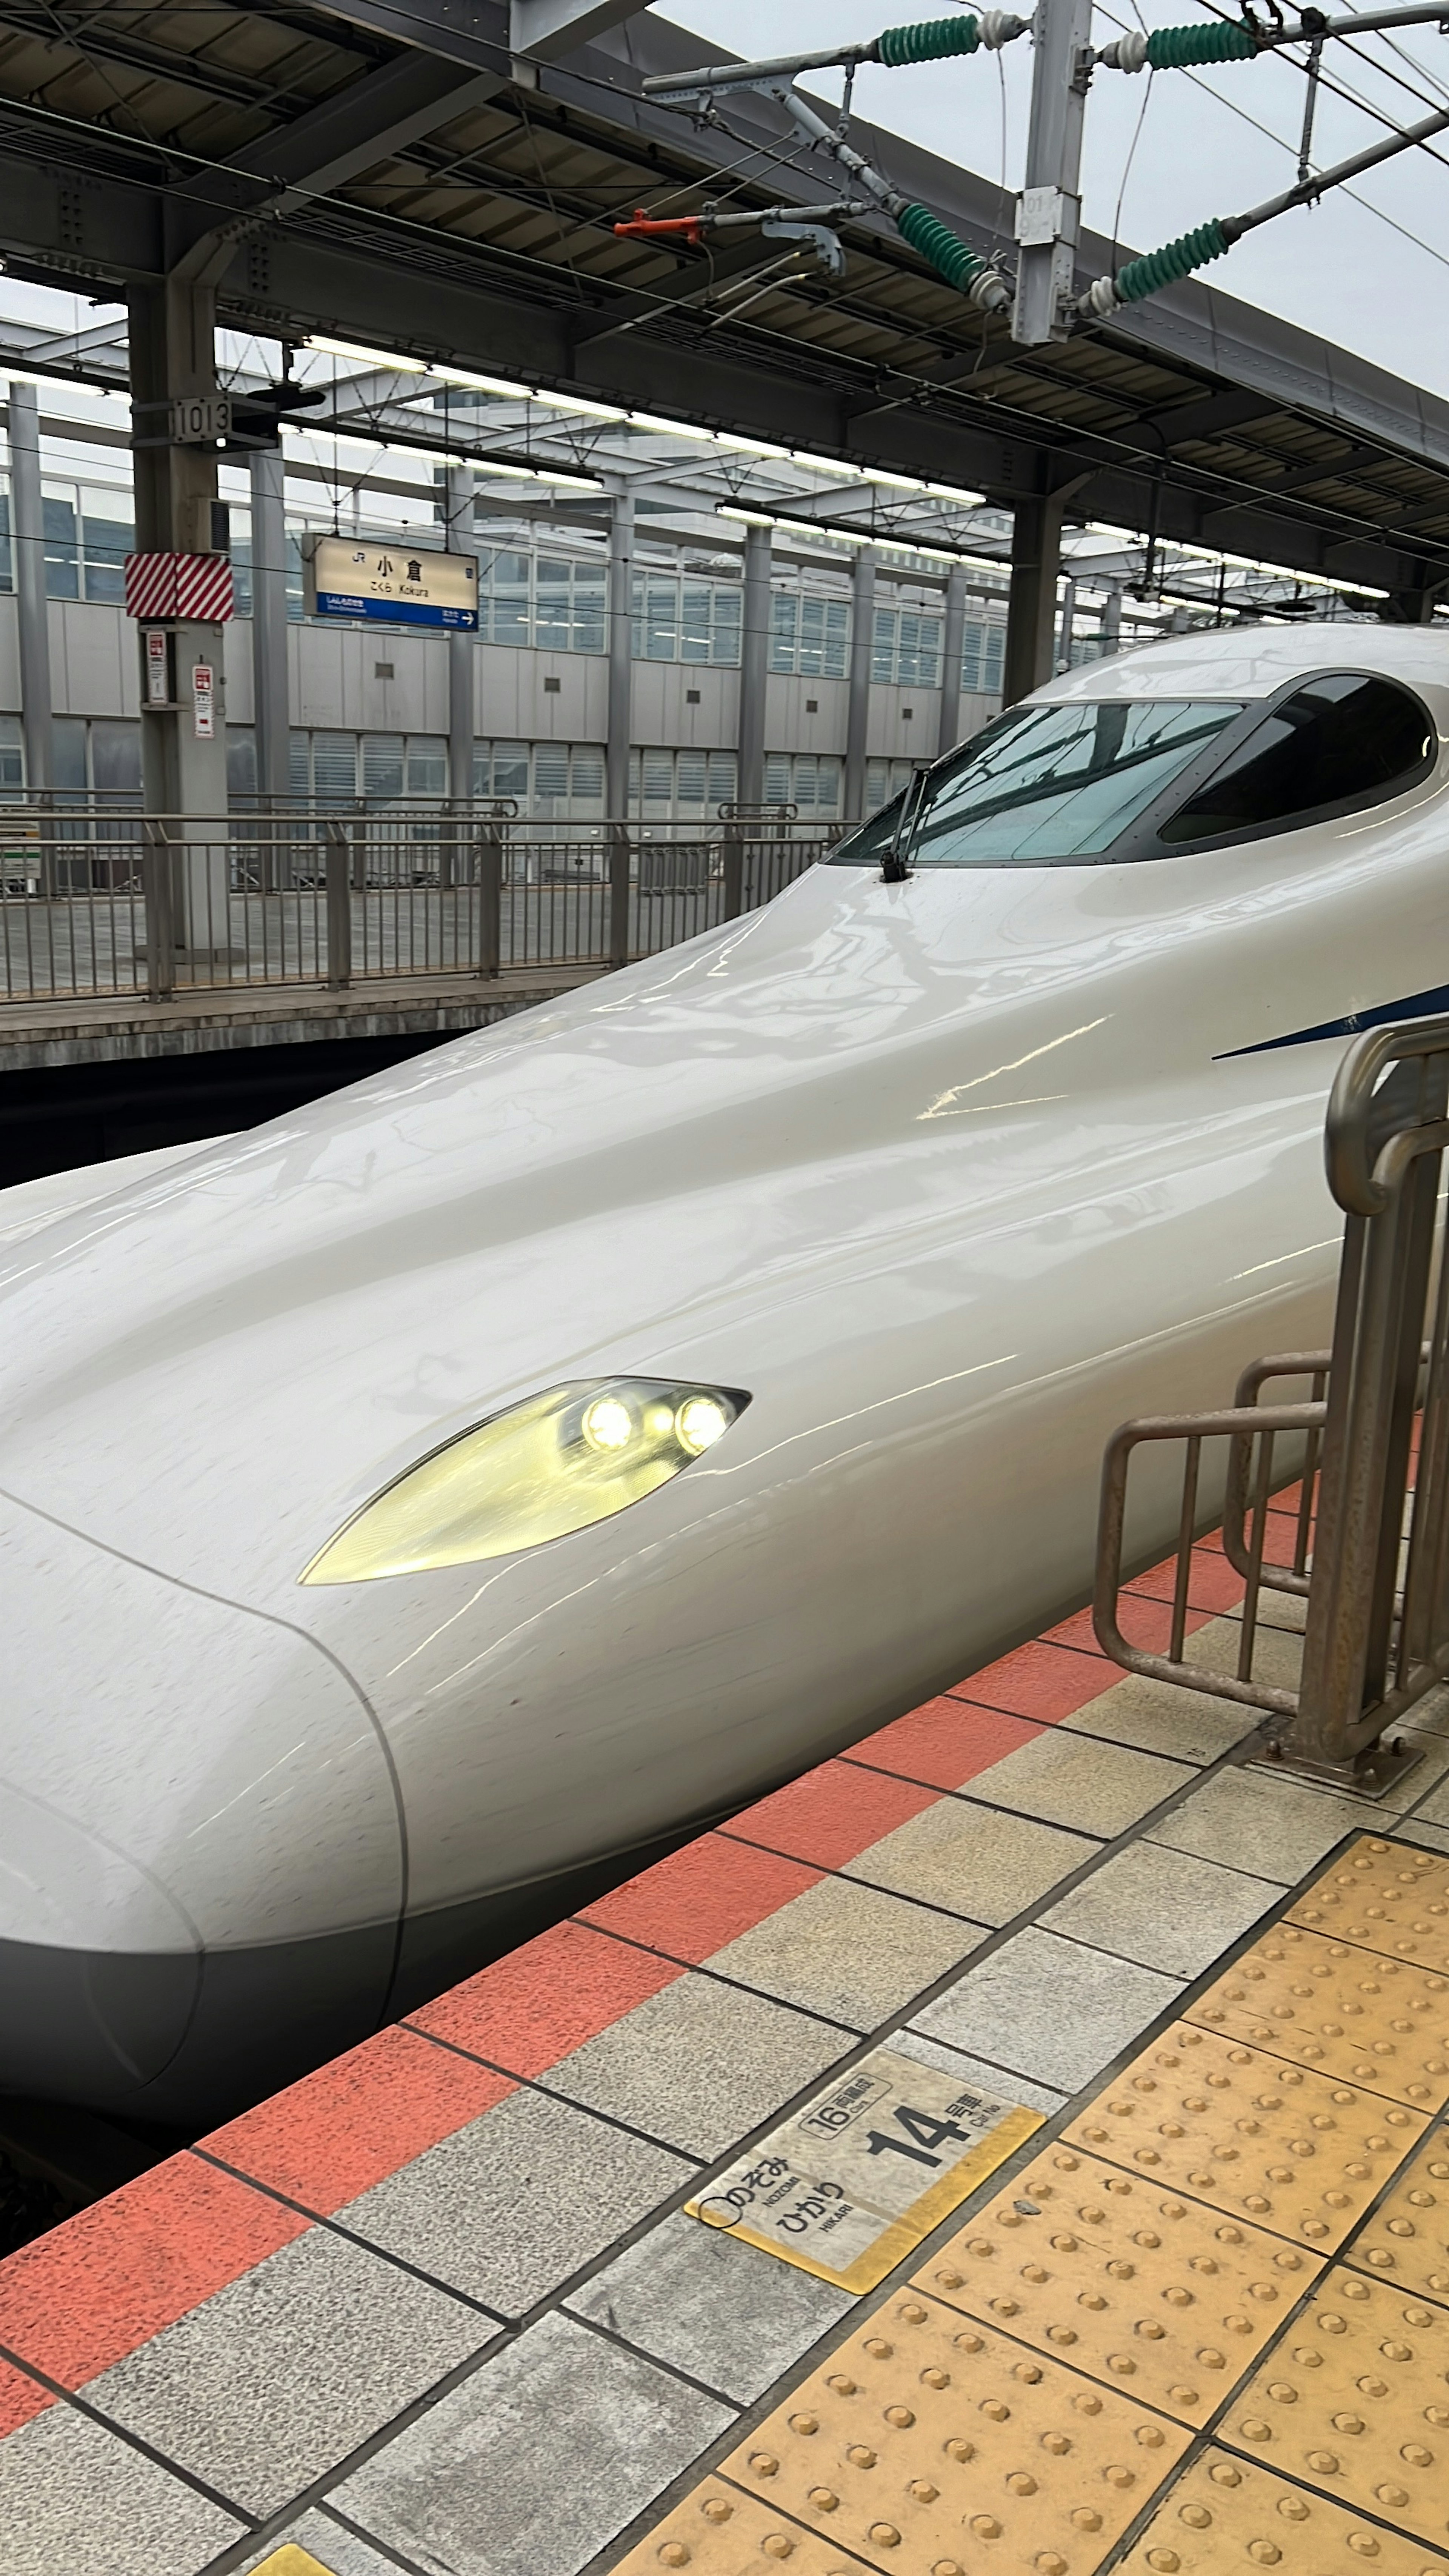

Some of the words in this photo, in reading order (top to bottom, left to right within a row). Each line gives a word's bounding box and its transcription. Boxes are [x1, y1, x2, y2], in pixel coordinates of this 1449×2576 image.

[182, 403, 228, 434] 1013
[352, 552, 365, 563] JR
[378, 555, 422, 582] 小倉
[371, 581, 392, 592] こくら
[400, 585, 429, 597] Kokura
[808, 2107, 850, 2131] 16
[866, 2106, 971, 2168] 14
[944, 2094, 983, 2118] 号車
[726, 2157, 789, 2207] のぞみ
[762, 2176, 802, 2207] NOZOMI
[775, 2182, 845, 2233] ひかり
[818, 2204, 855, 2233] HIKARI
